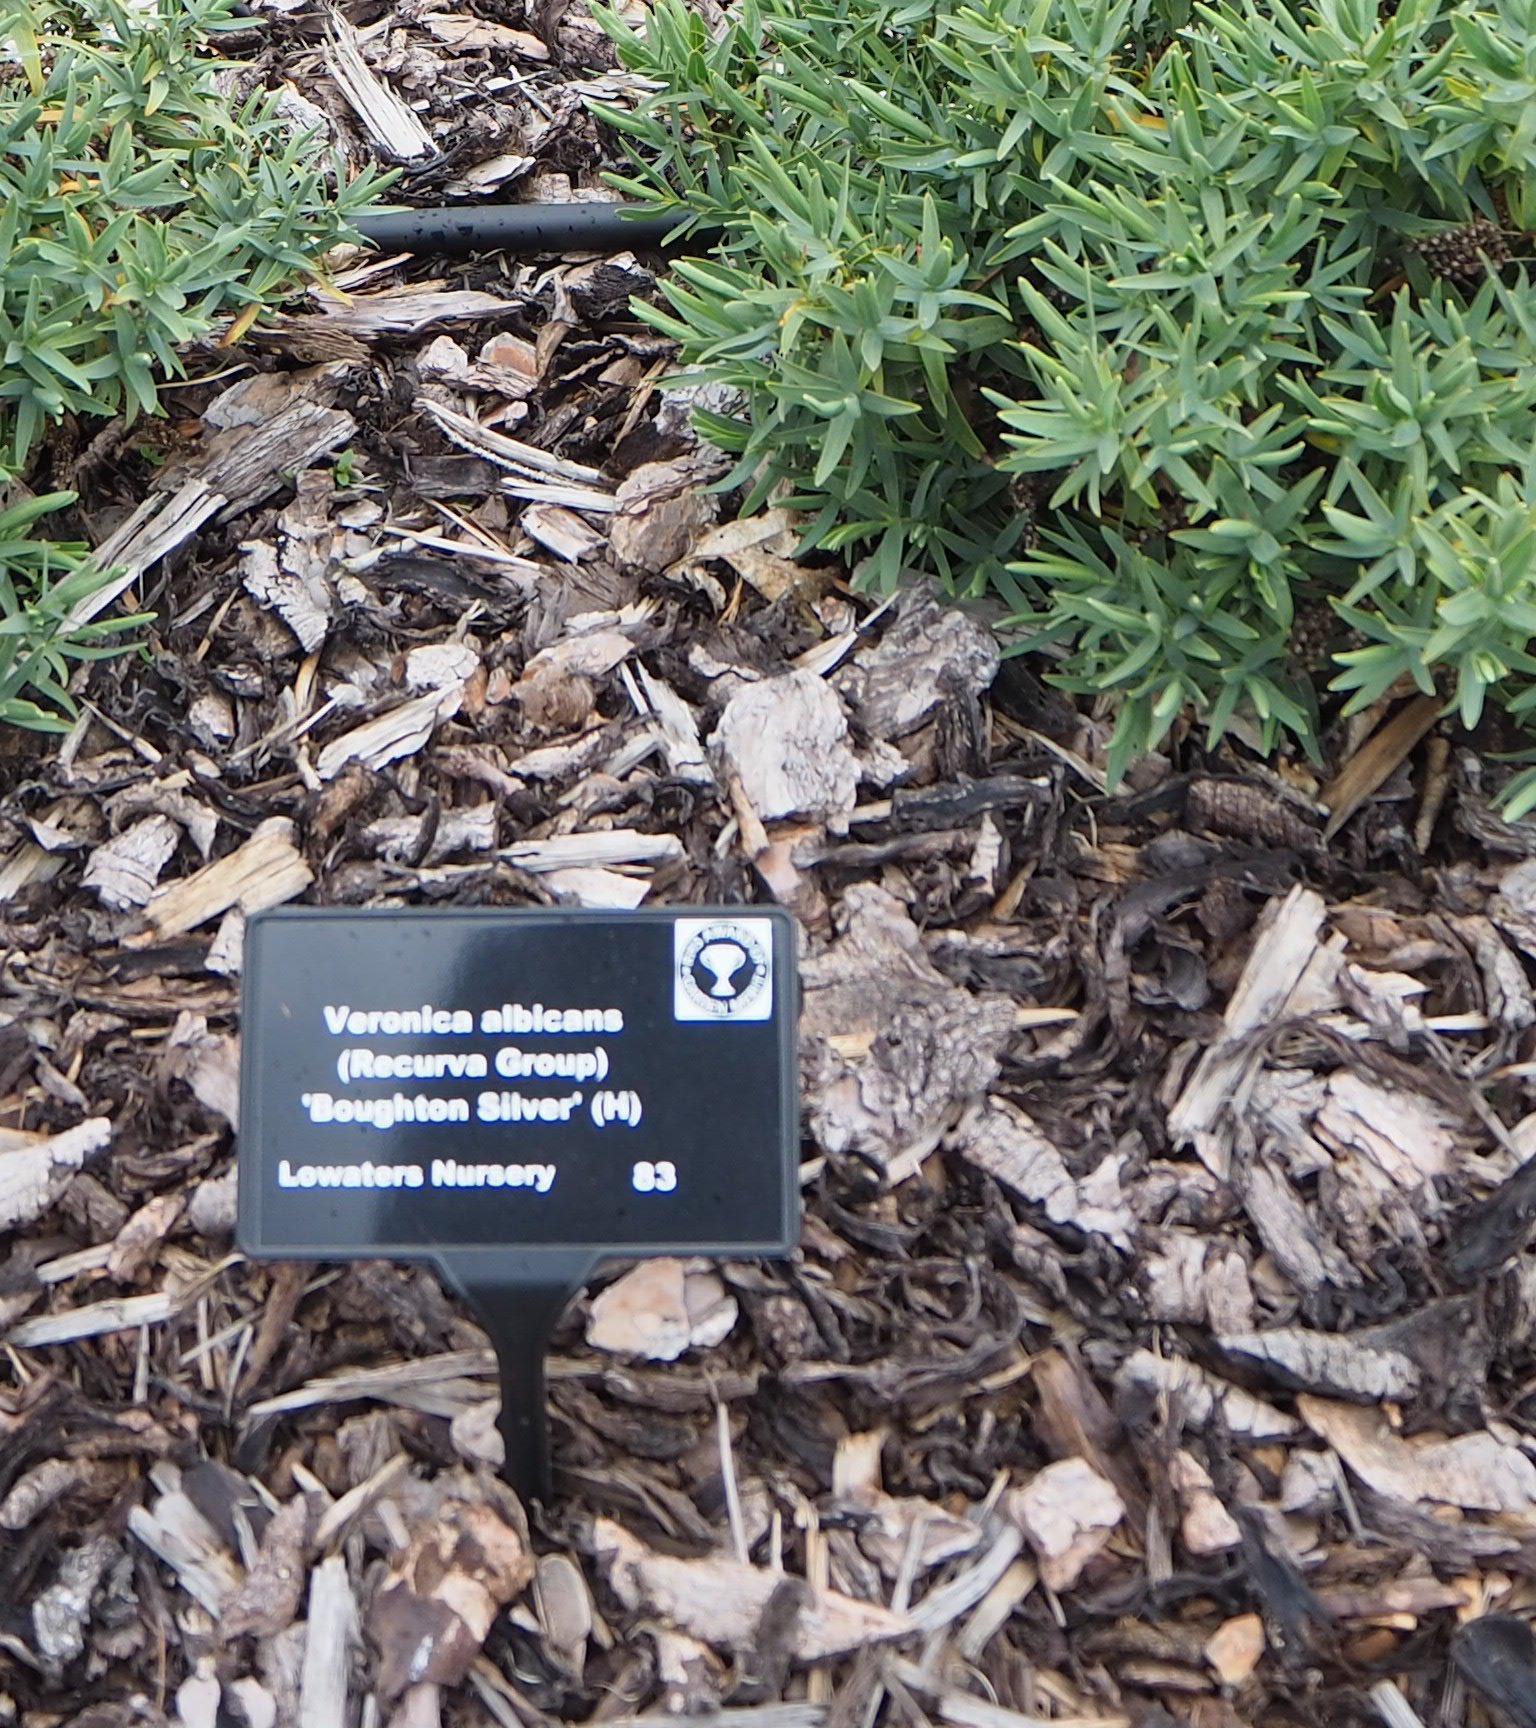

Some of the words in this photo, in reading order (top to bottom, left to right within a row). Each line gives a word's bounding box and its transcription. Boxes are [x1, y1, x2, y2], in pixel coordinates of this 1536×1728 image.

[322, 1004, 474, 1035] Veronica
[480, 1003, 624, 1034] albicans
[336, 1048, 489, 1084] (Recurva
[494, 1046, 609, 1082] Group)
[591, 1090, 642, 1127] (H)
[278, 1159, 424, 1189] Lowaters
[431, 1159, 557, 1192] Nursery
[632, 1160, 677, 1192] 83
